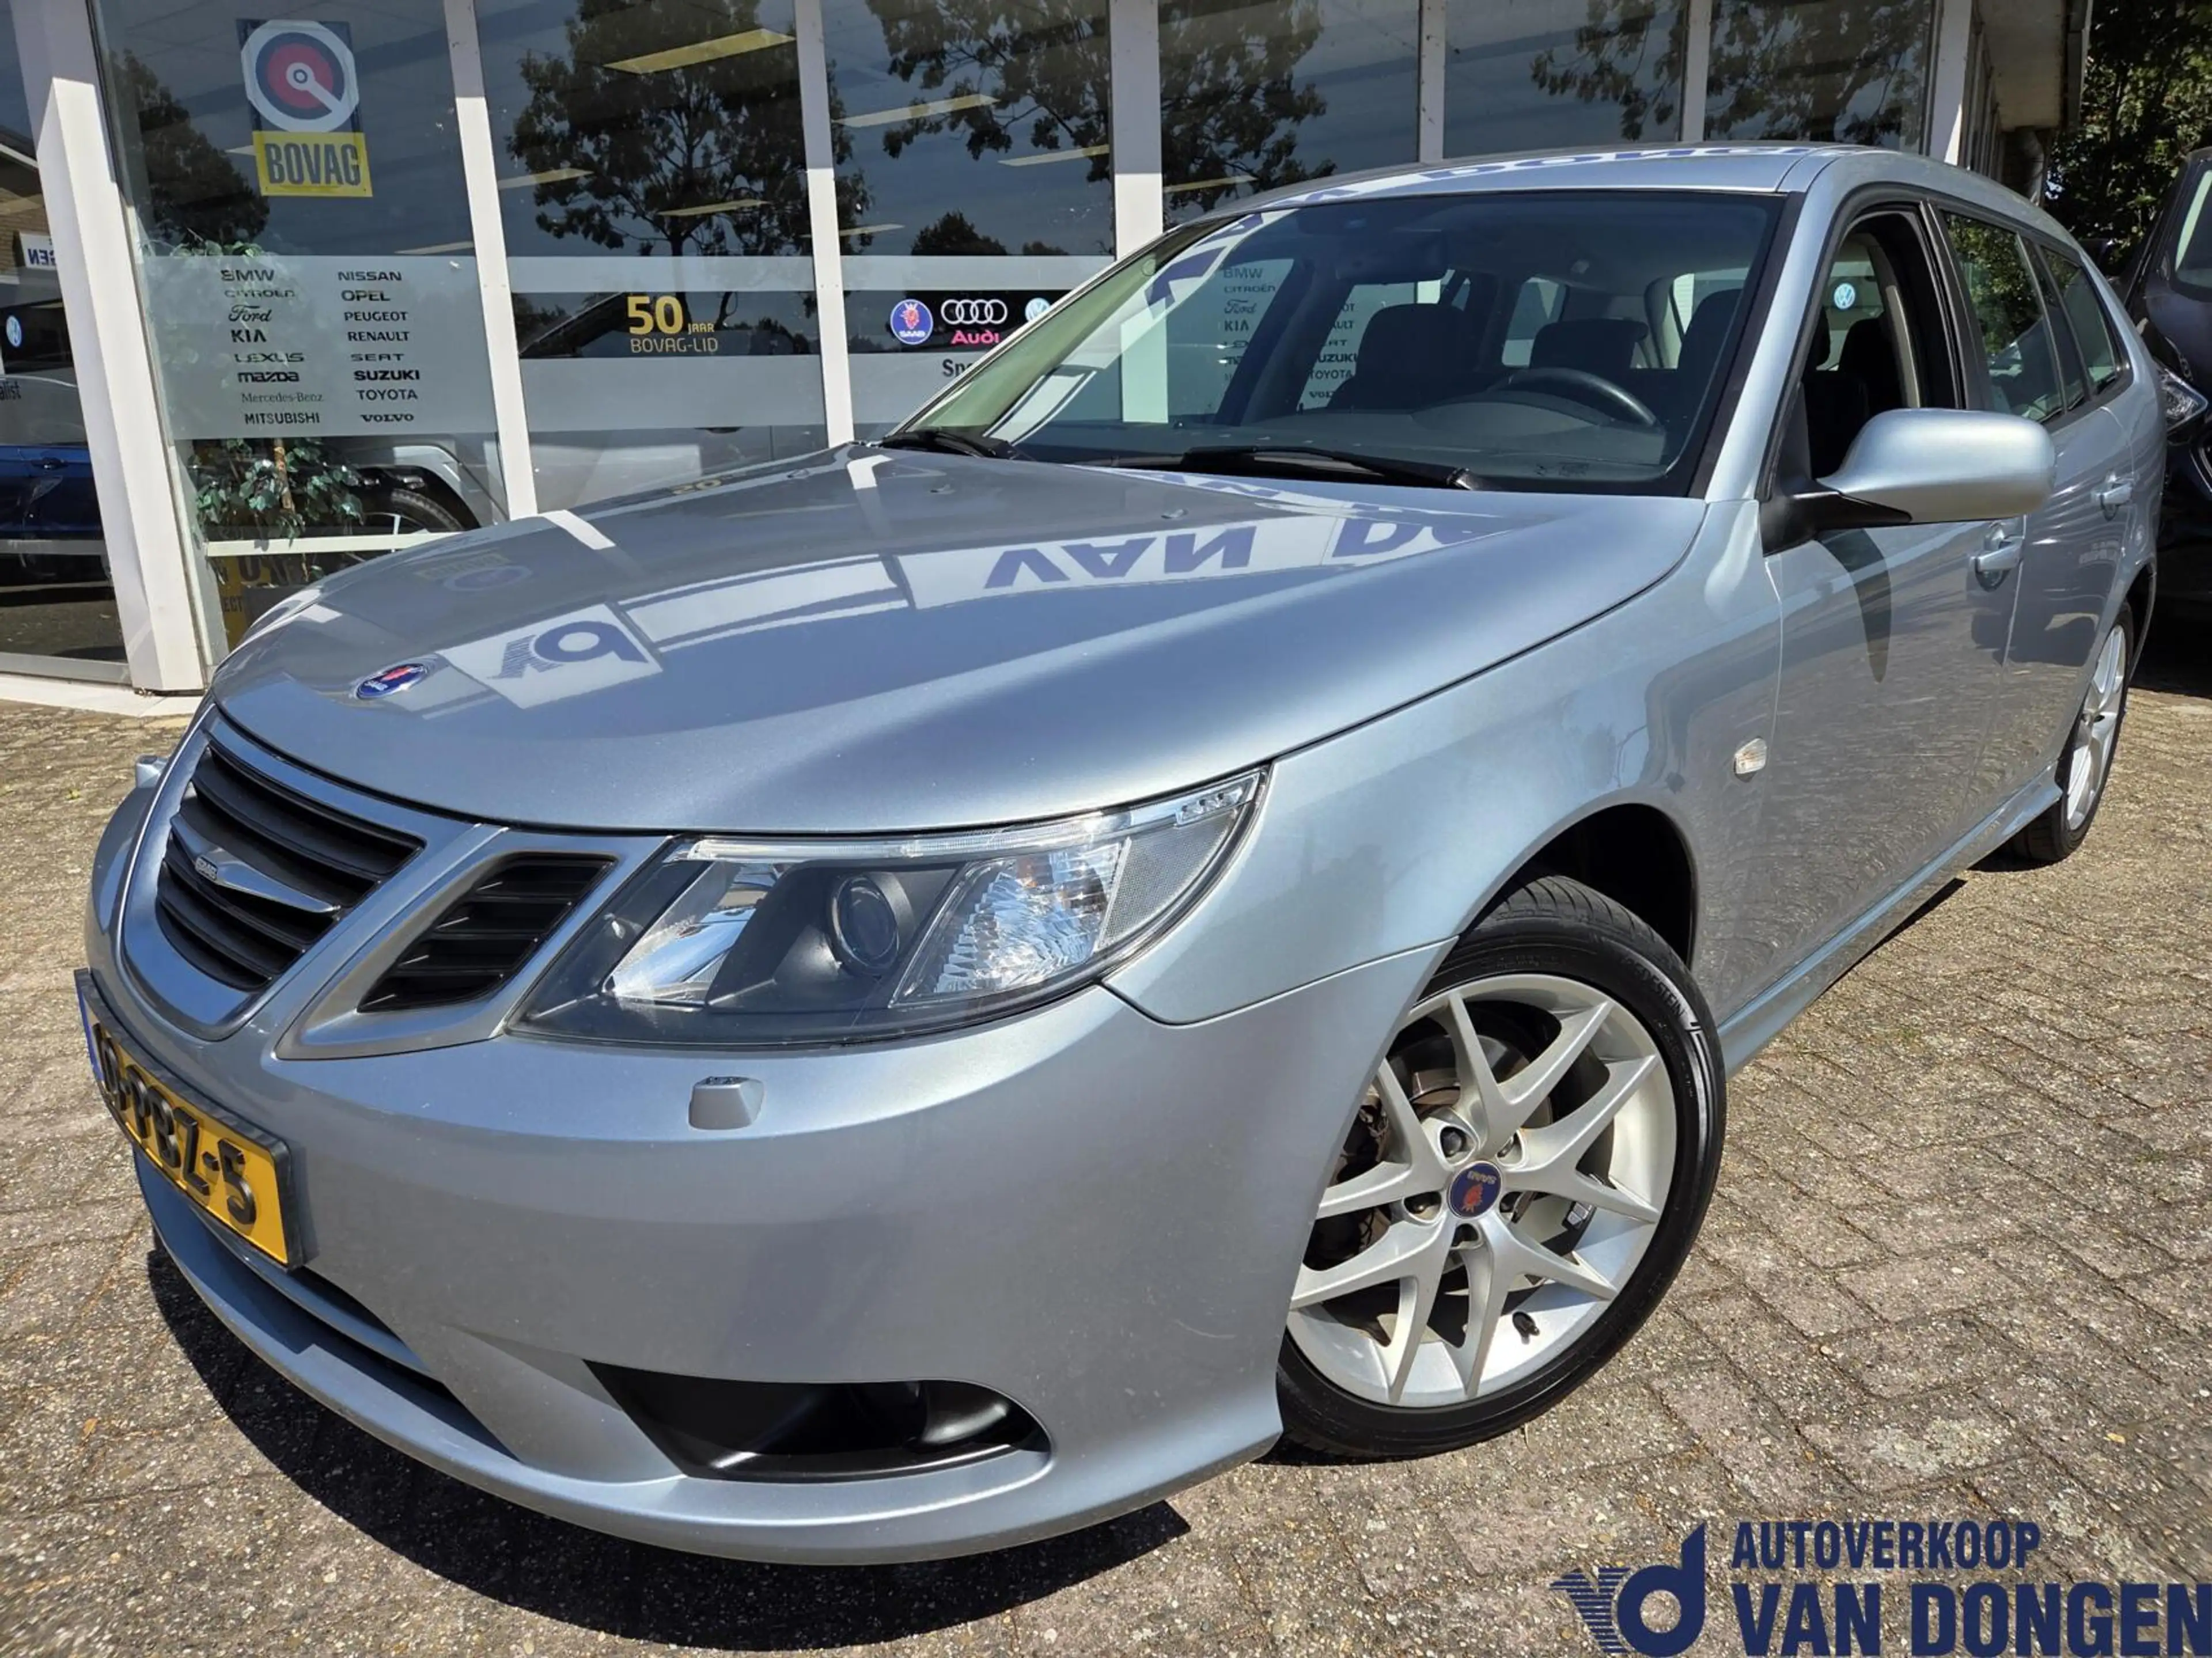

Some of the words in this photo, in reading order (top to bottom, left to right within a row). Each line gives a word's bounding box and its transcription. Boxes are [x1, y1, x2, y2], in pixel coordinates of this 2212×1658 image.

[265, 143, 361, 185] BOVAG
[221, 269, 274, 281] BMW
[338, 271, 402, 281] NISSAN
[1224, 267, 1262, 279] BMW
[341, 290, 391, 301] OPEL
[228, 304, 272, 322] Ford
[344, 312, 408, 321] PEUGEOT
[627, 295, 683, 335] 50
[1225, 320, 1249, 332] KIA
[230, 329, 267, 343] KIA
[348, 331, 410, 342] RENAULT
[951, 330, 1000, 344] Audi
[630, 337, 718, 353] BOVAG-LID
[234, 352, 304, 363] LEXUS
[237, 371, 299, 382] mazda
[354, 370, 420, 381] SUZUKI
[242, 392, 323, 403] Mercedes-Benz
[356, 389, 418, 400] TOYOTA
[245, 412, 320, 424] MITSUBISHI
[360, 413, 415, 422] VOLVO
